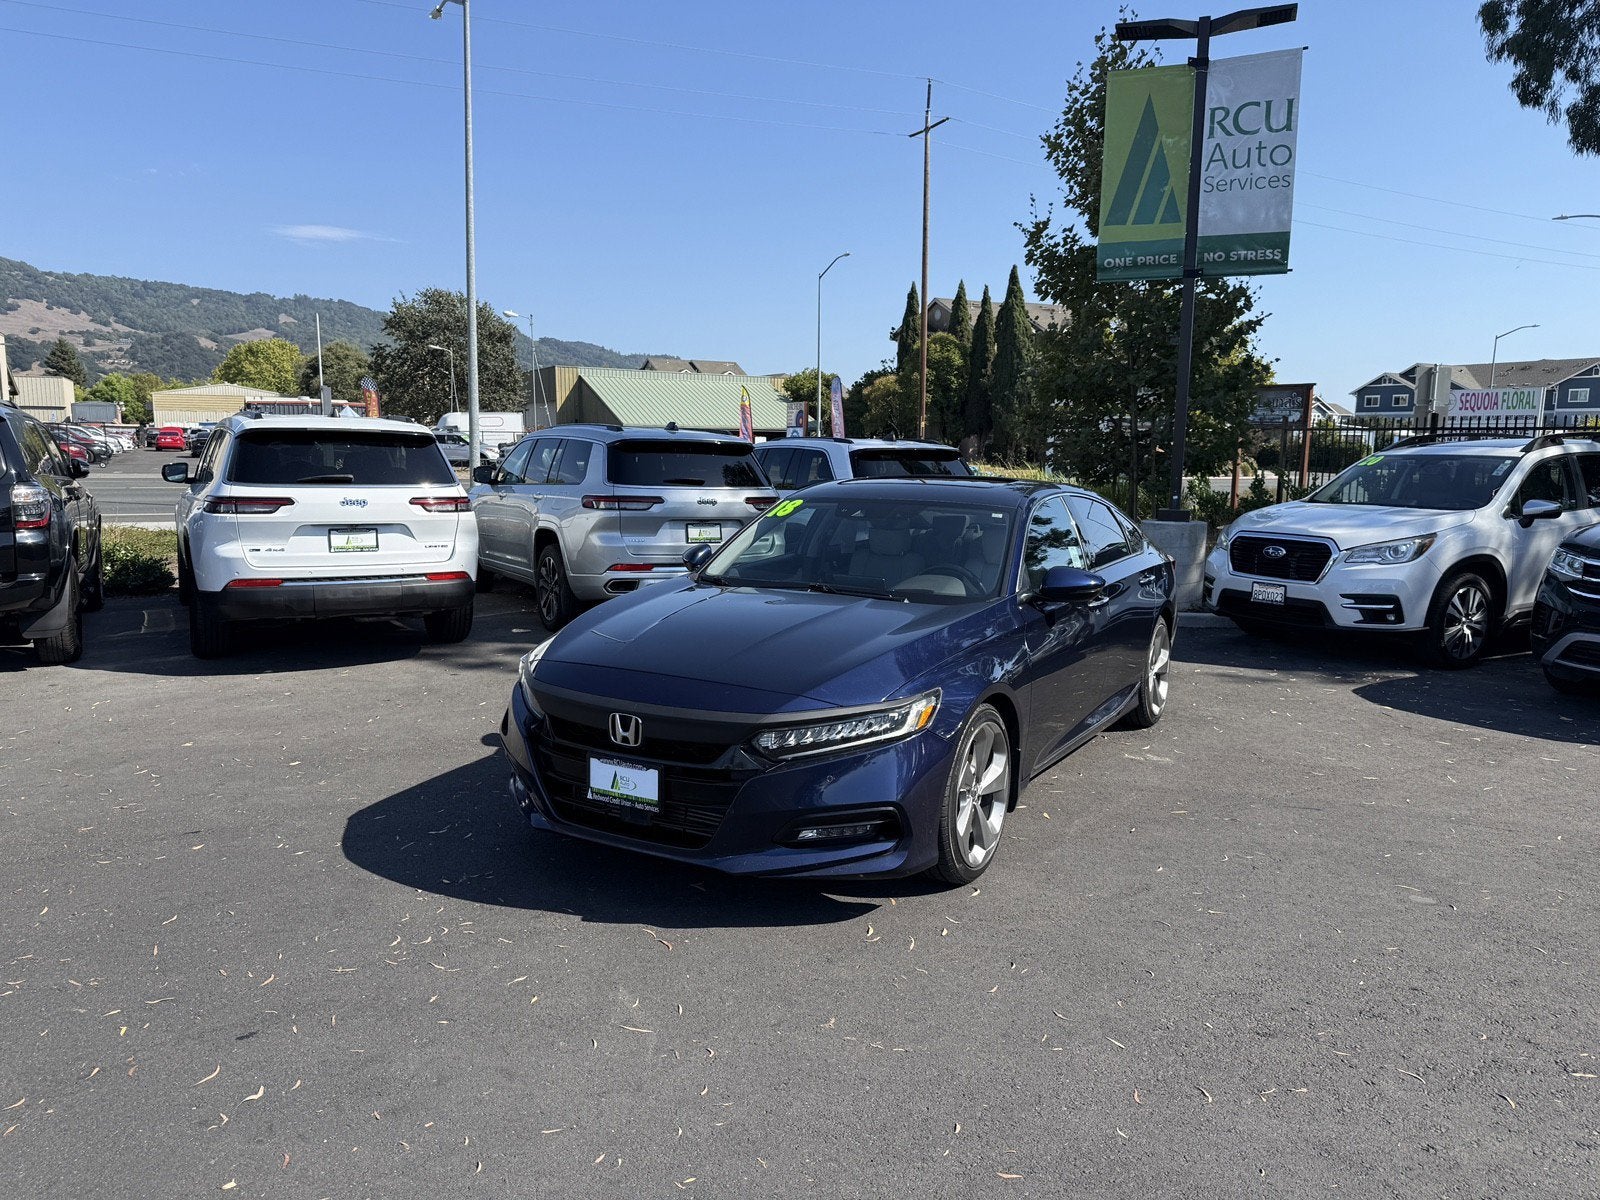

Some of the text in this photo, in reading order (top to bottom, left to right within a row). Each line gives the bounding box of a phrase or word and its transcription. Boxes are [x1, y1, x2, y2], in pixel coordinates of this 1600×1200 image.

[1207, 98, 1296, 140] RCU
[1204, 140, 1293, 172] Auto
[1203, 173, 1291, 193] Services
[1103, 254, 1178, 268] ONE PRICE
[1203, 249, 1282, 262] NO STRESS
[1458, 391, 1537, 412] SEQUOIA FLORAL
[340, 497, 368, 508] Jeep
[697, 496, 718, 506] Jeep
[767, 499, 804, 517] 18
